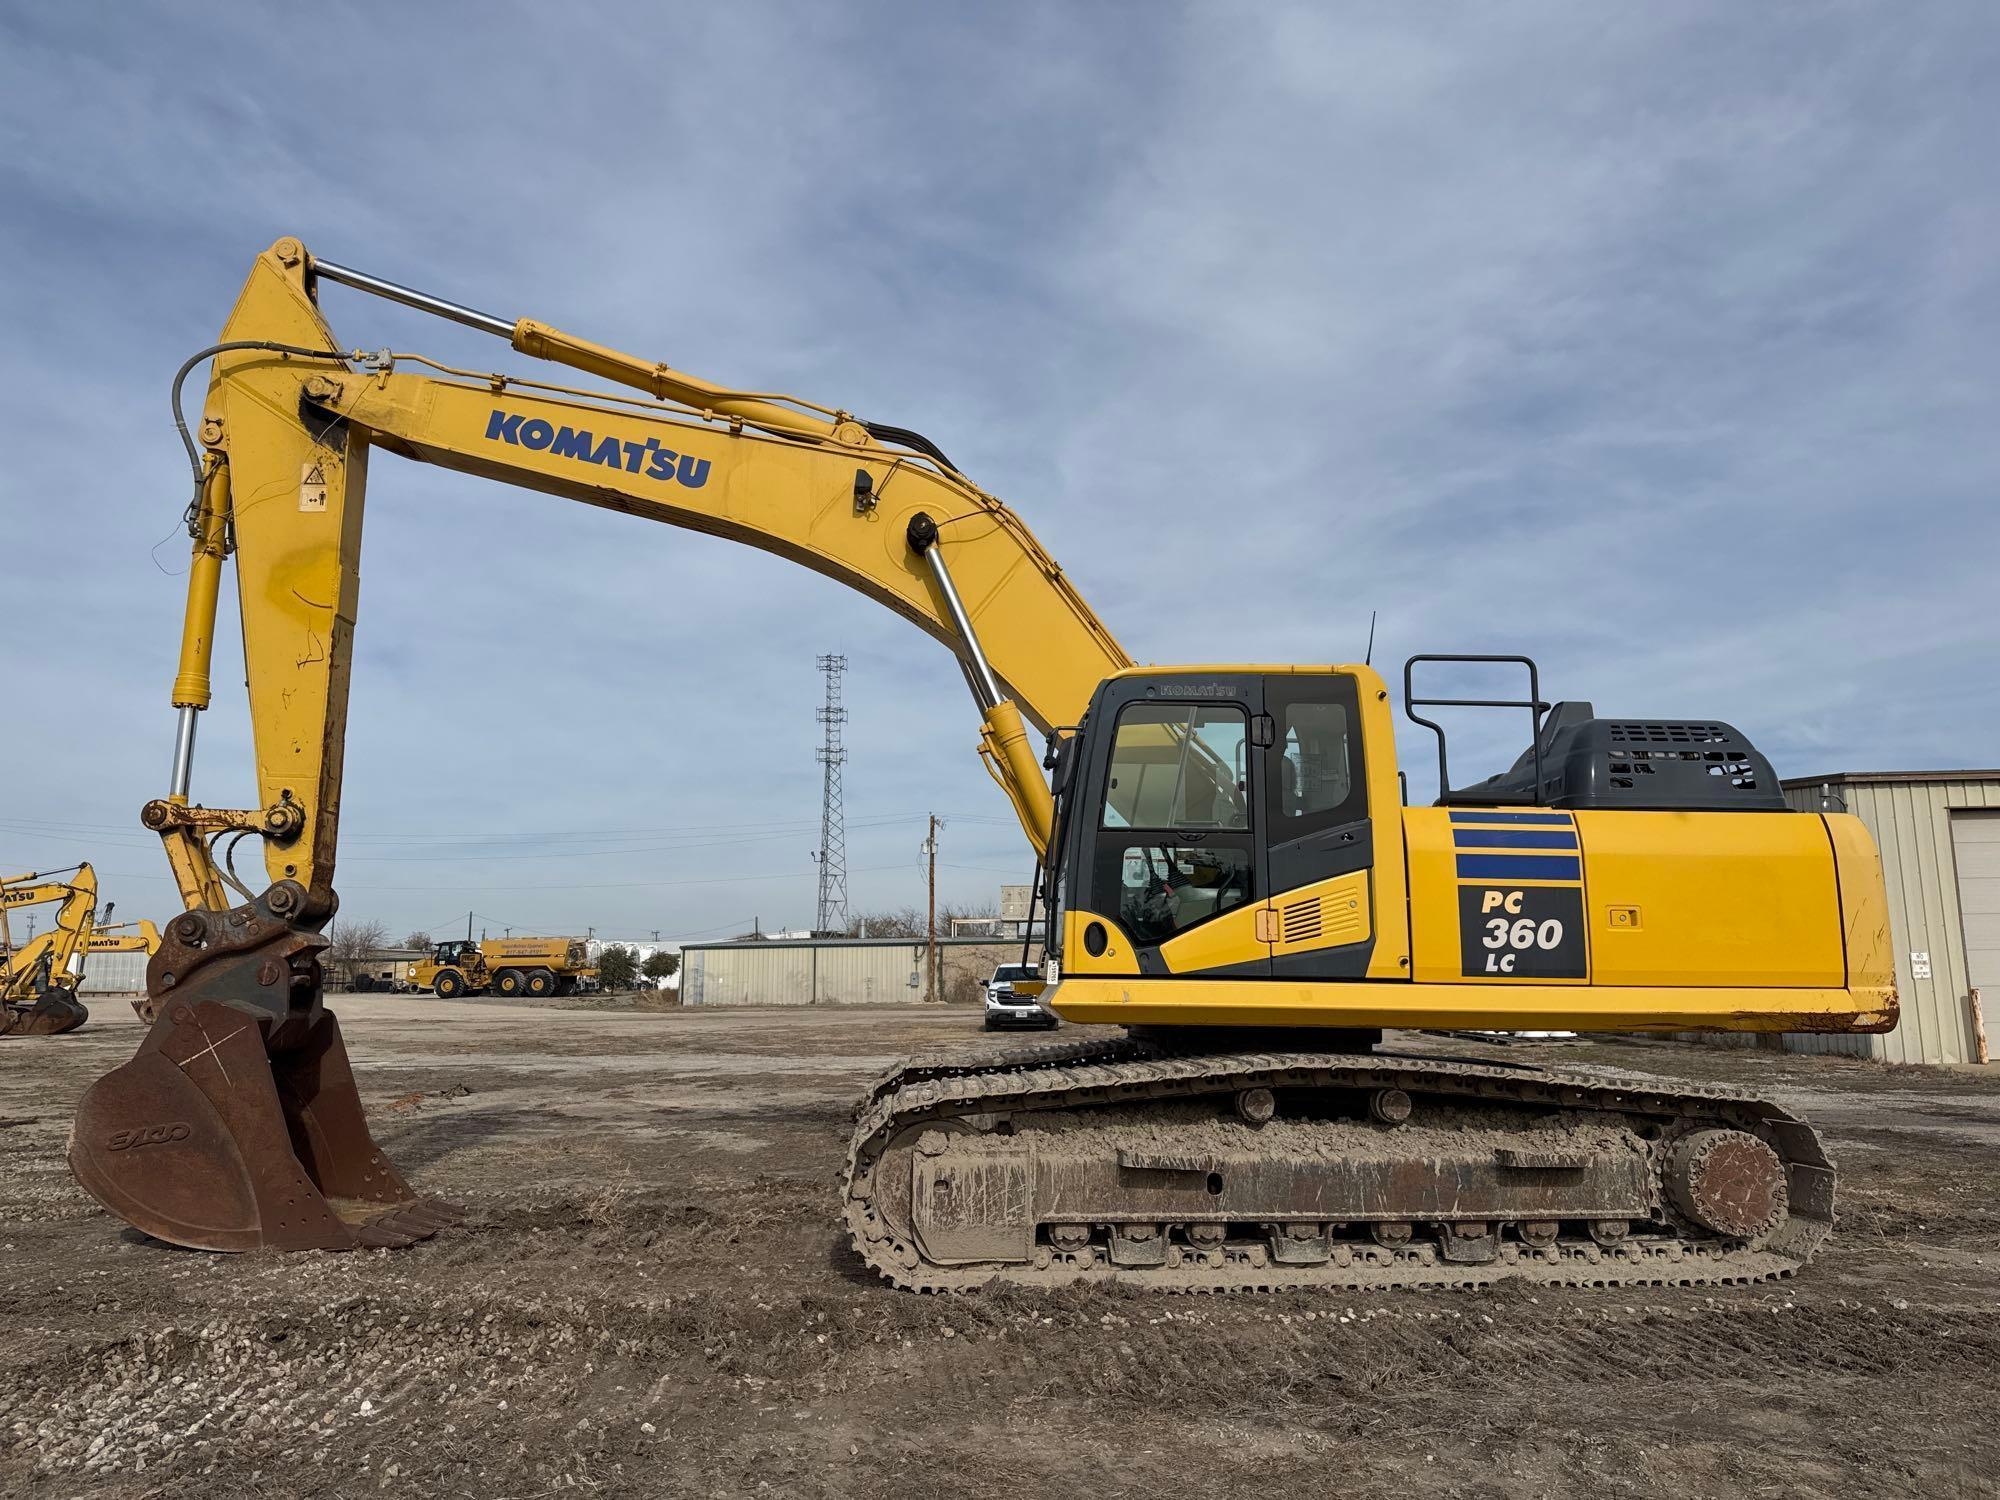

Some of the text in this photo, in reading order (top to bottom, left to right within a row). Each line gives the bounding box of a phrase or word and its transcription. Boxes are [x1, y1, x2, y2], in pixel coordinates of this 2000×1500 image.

[485, 409, 712, 489] KOMATSU
[1160, 682, 1237, 697] KOMATSU
[4, 891, 35, 902] ATSU
[1481, 890, 1524, 914] PC
[1482, 918, 1564, 950] 360
[1485, 953, 1516, 973] LC
